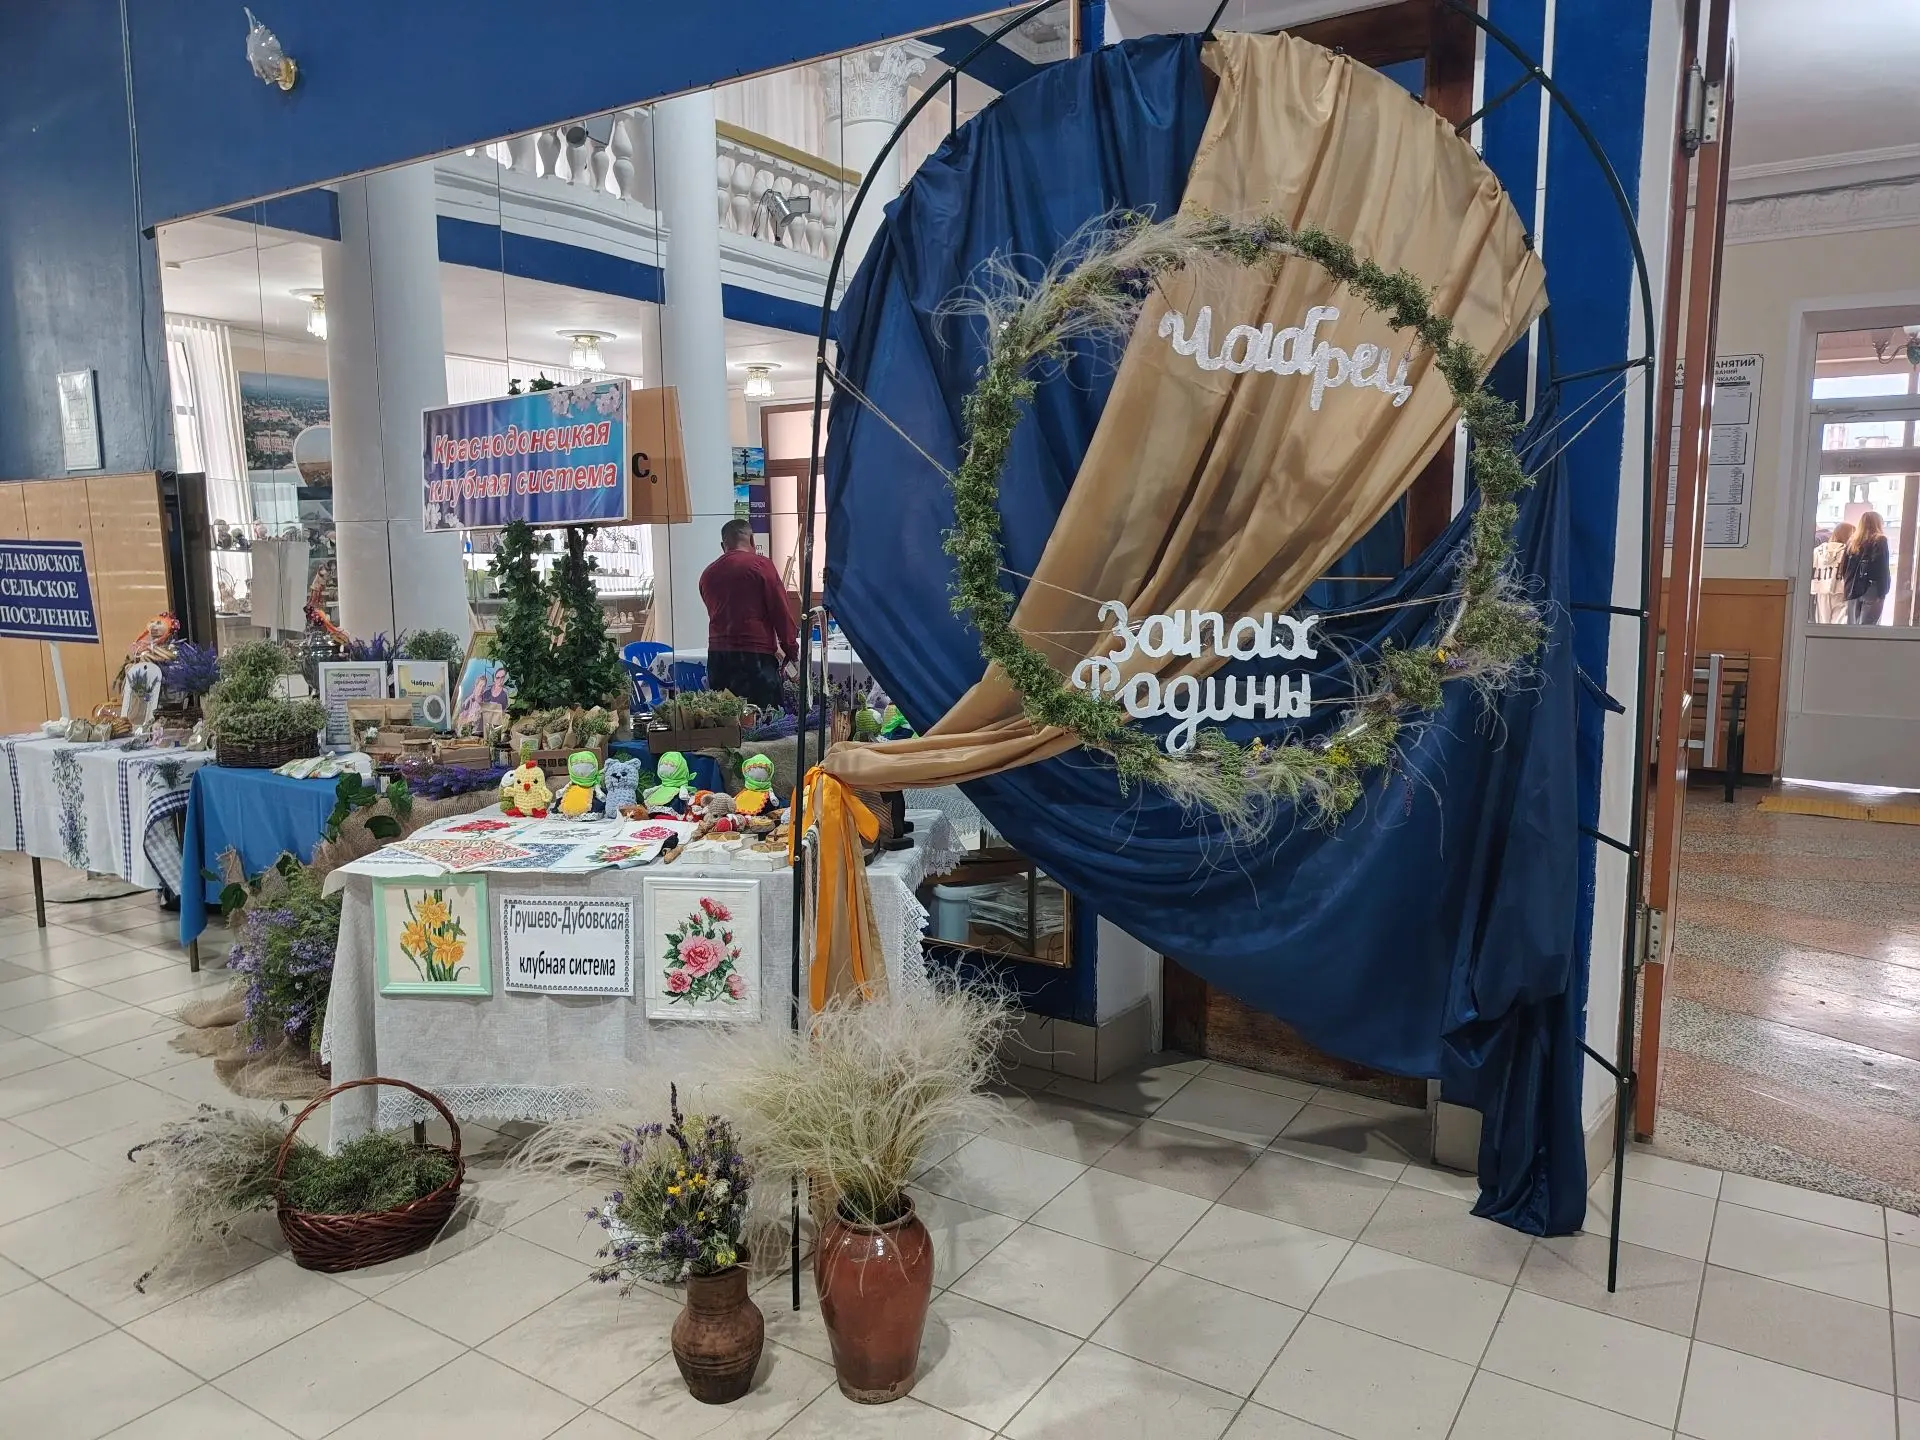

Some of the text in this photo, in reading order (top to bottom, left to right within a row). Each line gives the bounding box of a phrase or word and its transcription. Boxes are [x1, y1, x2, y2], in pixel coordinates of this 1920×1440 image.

[1158, 305, 1413, 411] Чабрец
[1715, 357, 1756, 369] АНЯТИЙ
[432, 420, 612, 470] Краснодонецкая
[429, 461, 617, 508] клубная система
[1, 577, 79, 599] СЕЛЬСКОЕ
[0, 605, 92, 628] ПОСЕЛЕНИЕ
[1098, 600, 1319, 662] Запах
[411, 679, 435, 688] Чабрец
[1071, 656, 1312, 754] Родины
[509, 904, 625, 935] Грушево-Дубовская
[519, 951, 616, 979] клубная система
